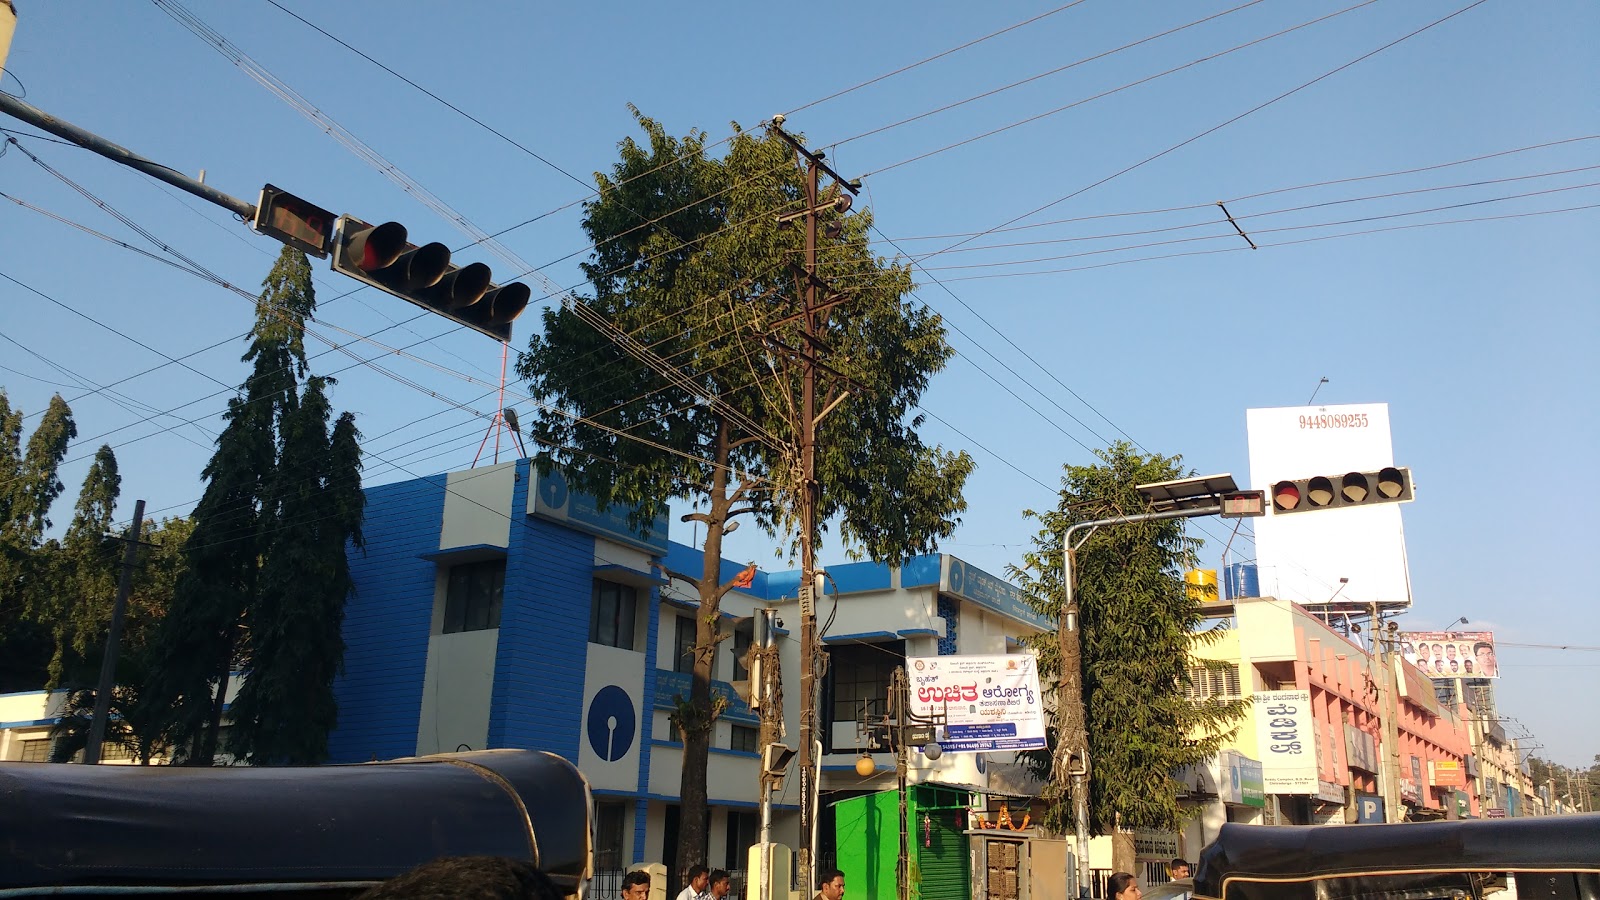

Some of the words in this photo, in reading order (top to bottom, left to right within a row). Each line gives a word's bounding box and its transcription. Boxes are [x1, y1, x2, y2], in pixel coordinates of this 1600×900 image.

[1299, 413, 1369, 429] 9448089255
[916, 675, 938, 686] ಬೃಹತ್
[918, 680, 978, 703] ಉಚಿತ
[982, 683, 1034, 705] ಆರೋಗ್ಯ
[1263, 693, 1271, 703] ಶ್ರೀ
[1273, 693, 1299, 702] ರಂಗನಾಥ
[1267, 704, 1302, 754] ಮೆಡಿಕಲ್ಸ್
[1364, 800, 1377, 819] P
